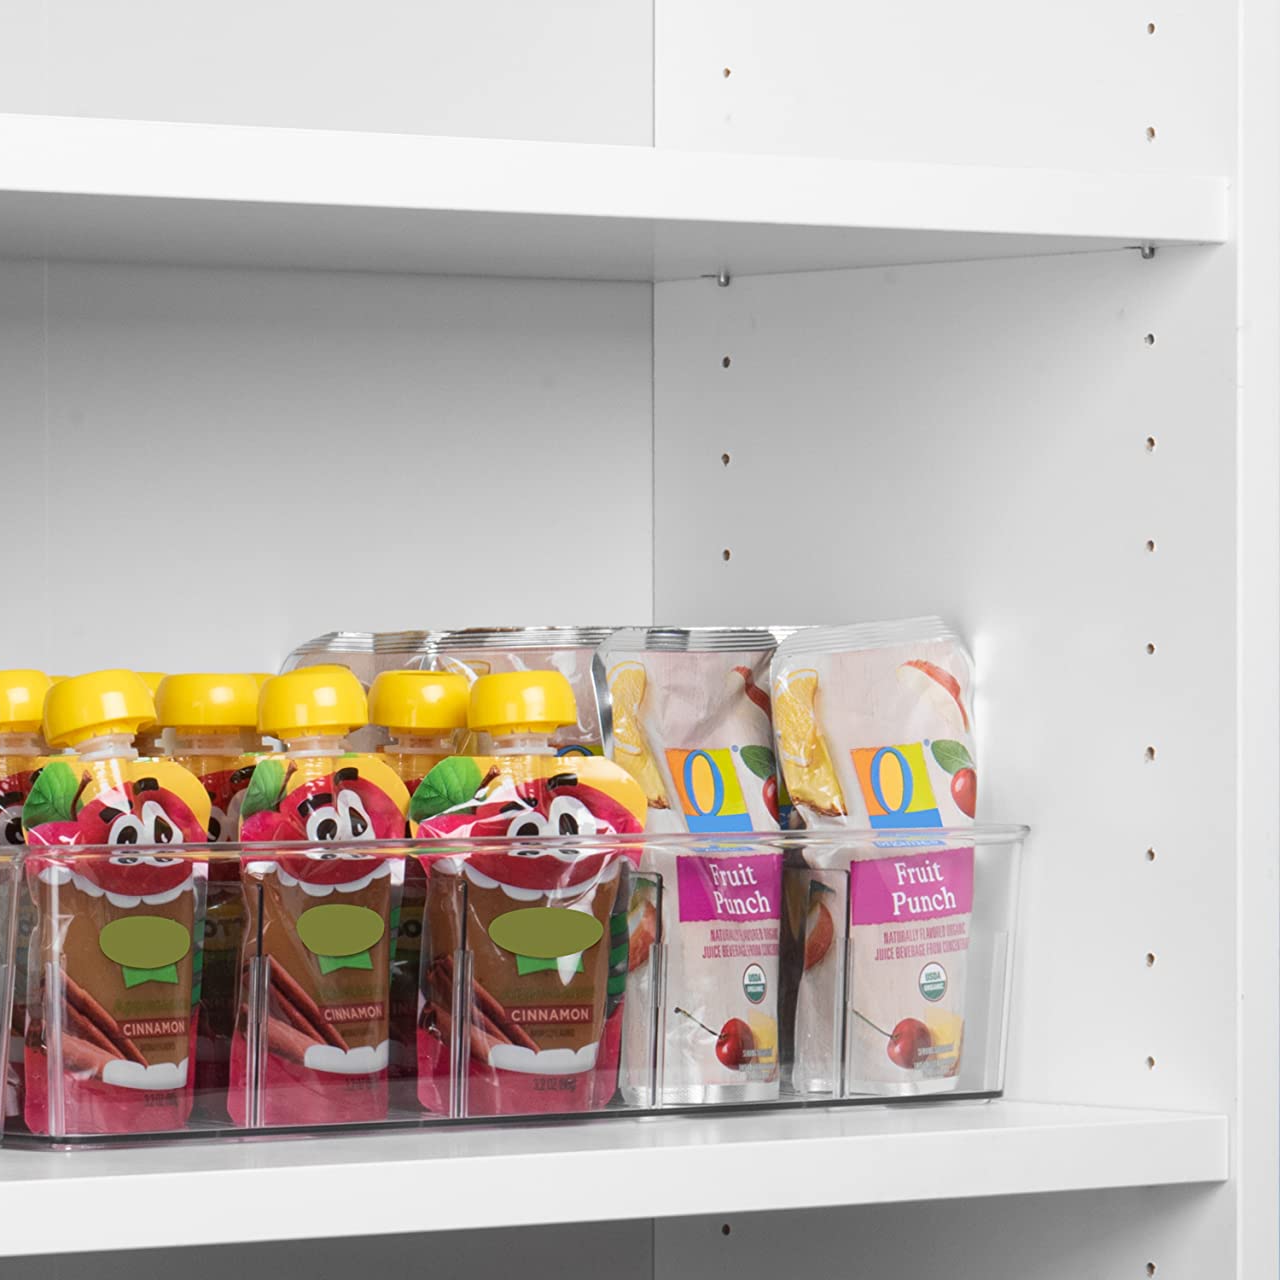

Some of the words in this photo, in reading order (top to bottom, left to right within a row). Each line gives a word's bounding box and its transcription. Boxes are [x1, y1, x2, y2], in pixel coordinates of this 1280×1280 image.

[709, 863, 757, 886] Fruit
[894, 860, 944, 885] Fruit
[713, 890, 771, 915] Punch
[892, 886, 957, 916] Punch
[702, 946, 721, 959] JUICE
[875, 947, 895, 961] JUICE
[324, 1007, 382, 1021] CINNAMON
[511, 1008, 589, 1021] CINNAMON
[123, 1020, 185, 1036] CINNAMON
